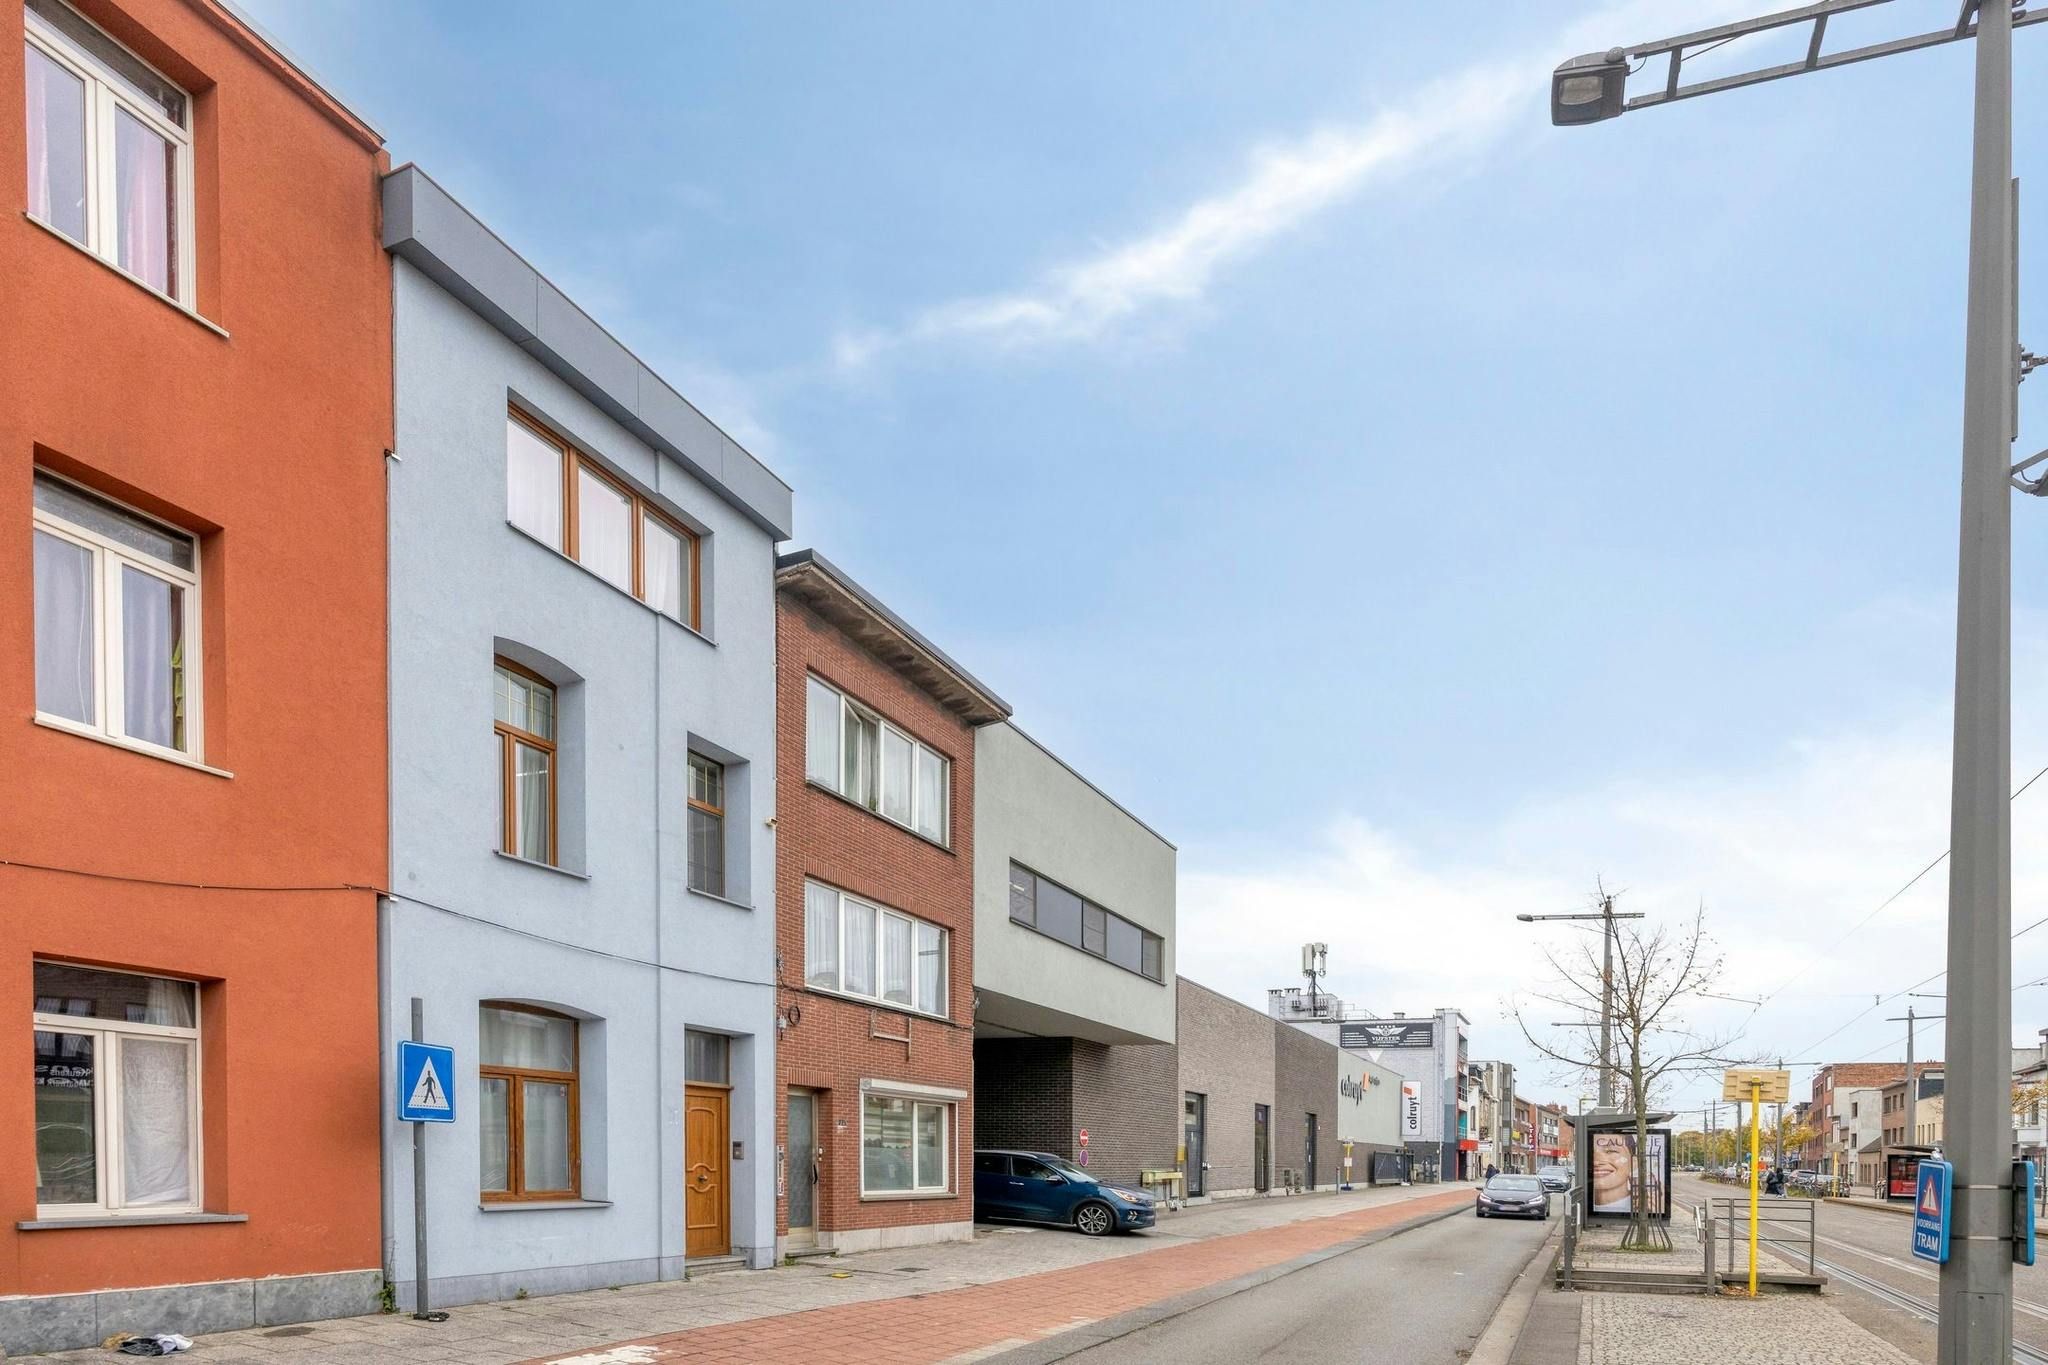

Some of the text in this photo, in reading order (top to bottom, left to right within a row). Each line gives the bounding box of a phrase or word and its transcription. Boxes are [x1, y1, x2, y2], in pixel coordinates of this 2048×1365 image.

[1407, 1097, 1420, 1130] colruyt
[1596, 1137, 1662, 1147] CAUIE
[1917, 1218, 1941, 1232] VOORRANG
[1917, 1232, 1938, 1252] TRAM
